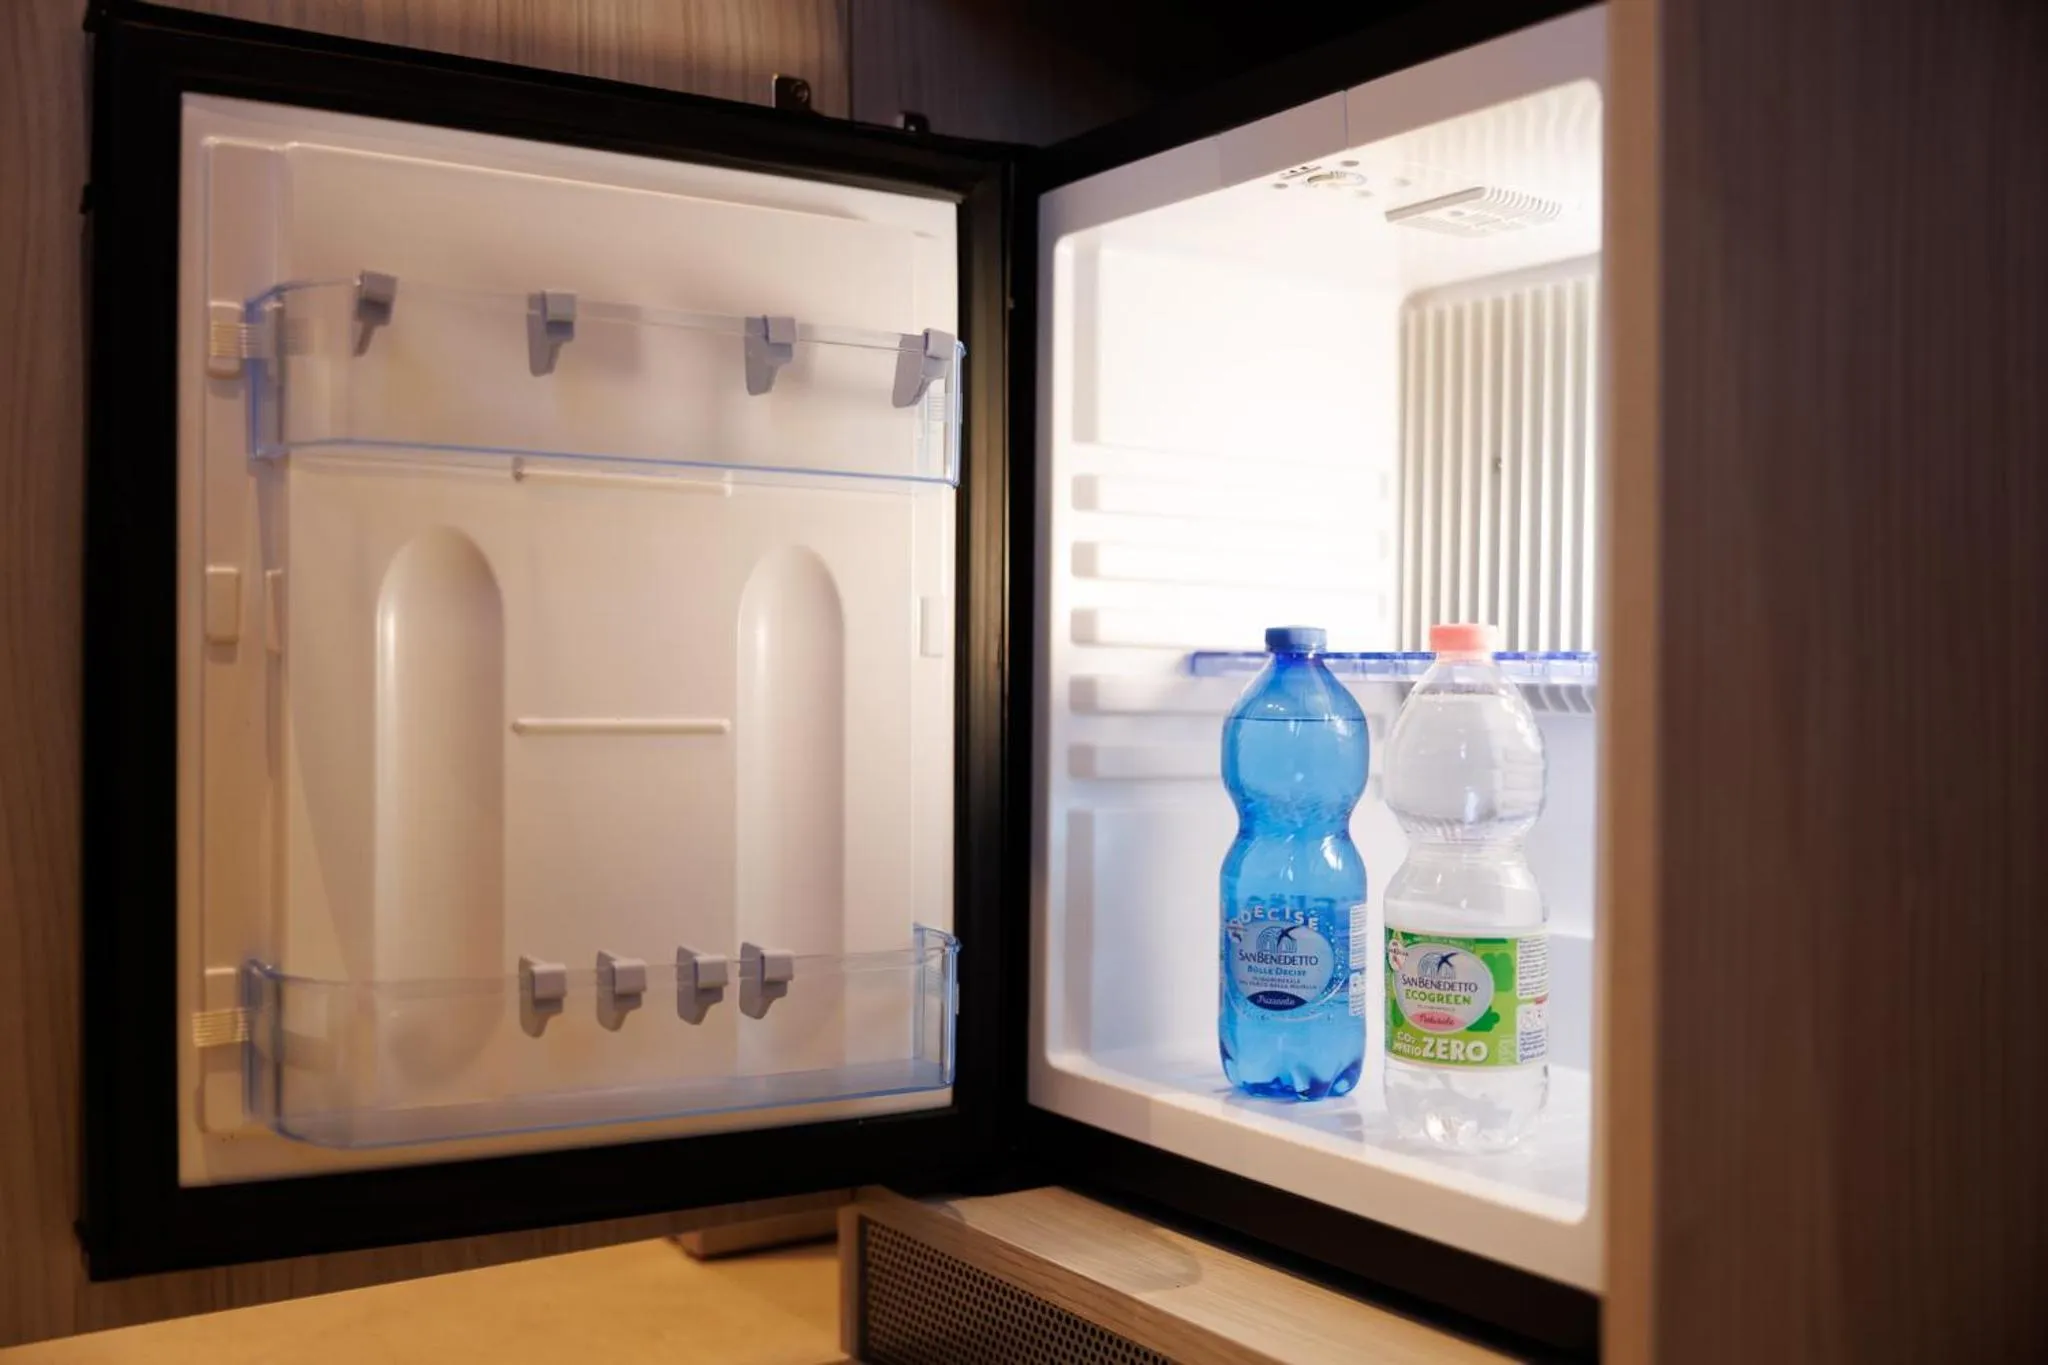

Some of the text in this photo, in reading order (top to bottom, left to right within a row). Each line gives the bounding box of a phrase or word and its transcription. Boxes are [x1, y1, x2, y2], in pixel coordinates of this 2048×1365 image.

[1240, 904, 1319, 931] DECISE
[1405, 990, 1471, 1005] ECOGREEN
[1423, 1037, 1488, 1062] ZERO
